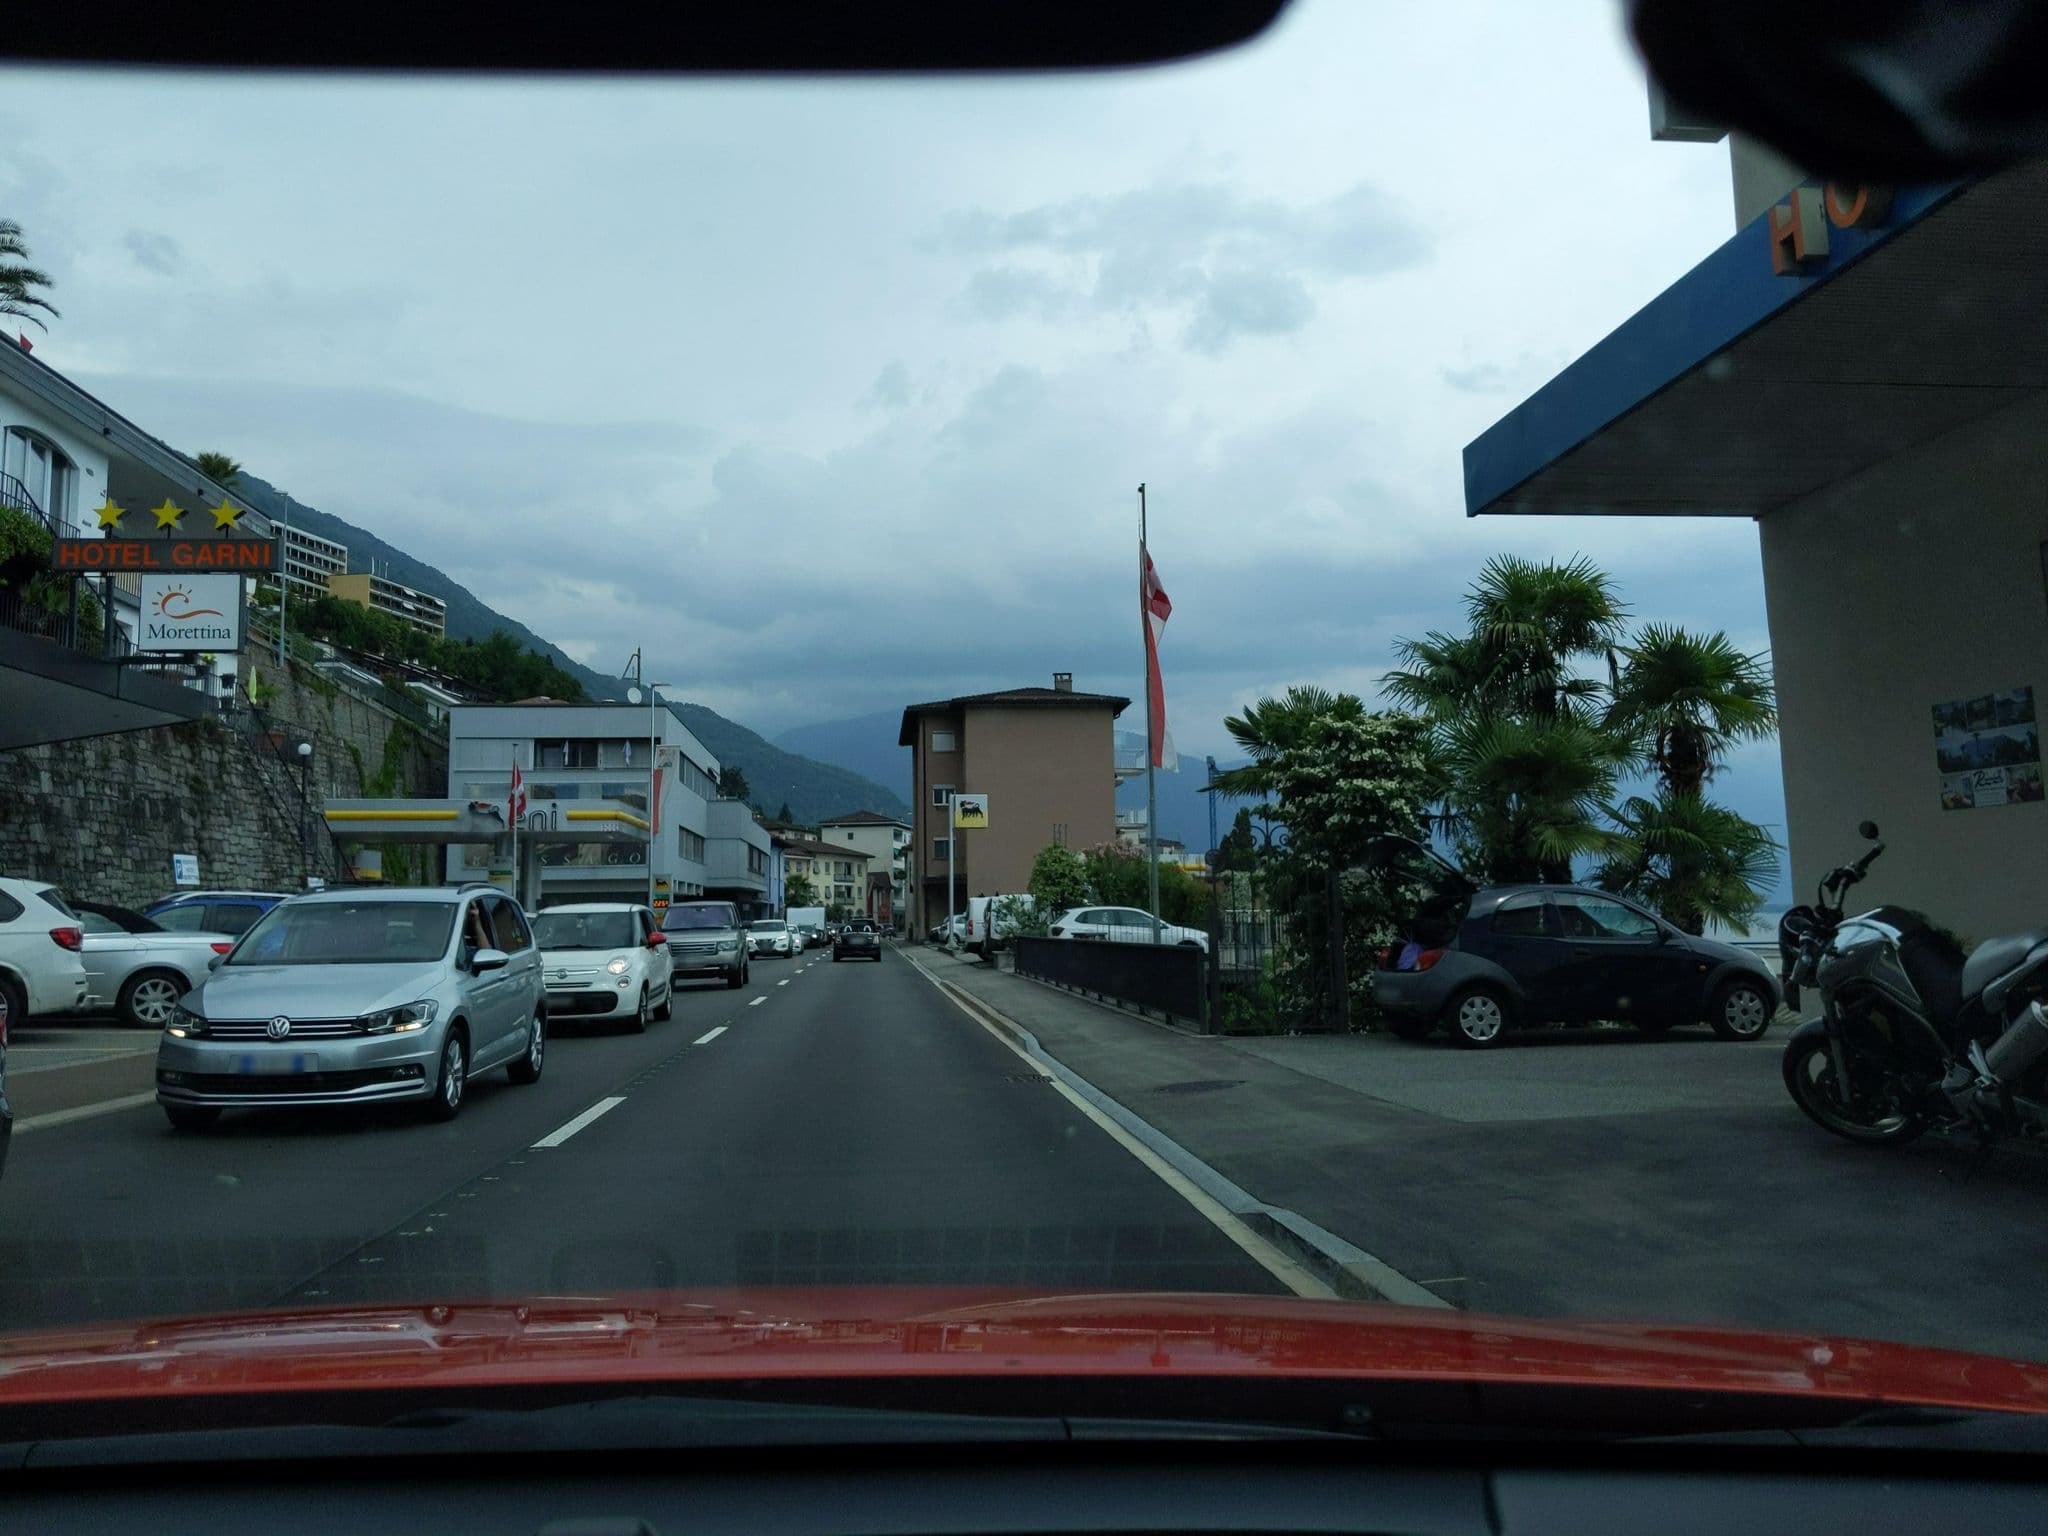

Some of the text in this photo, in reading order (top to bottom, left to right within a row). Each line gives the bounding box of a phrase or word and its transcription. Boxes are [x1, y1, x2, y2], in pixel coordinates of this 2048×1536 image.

[59, 542, 273, 567] HOTEL GARNI
[147, 623, 232, 640] Morettina
